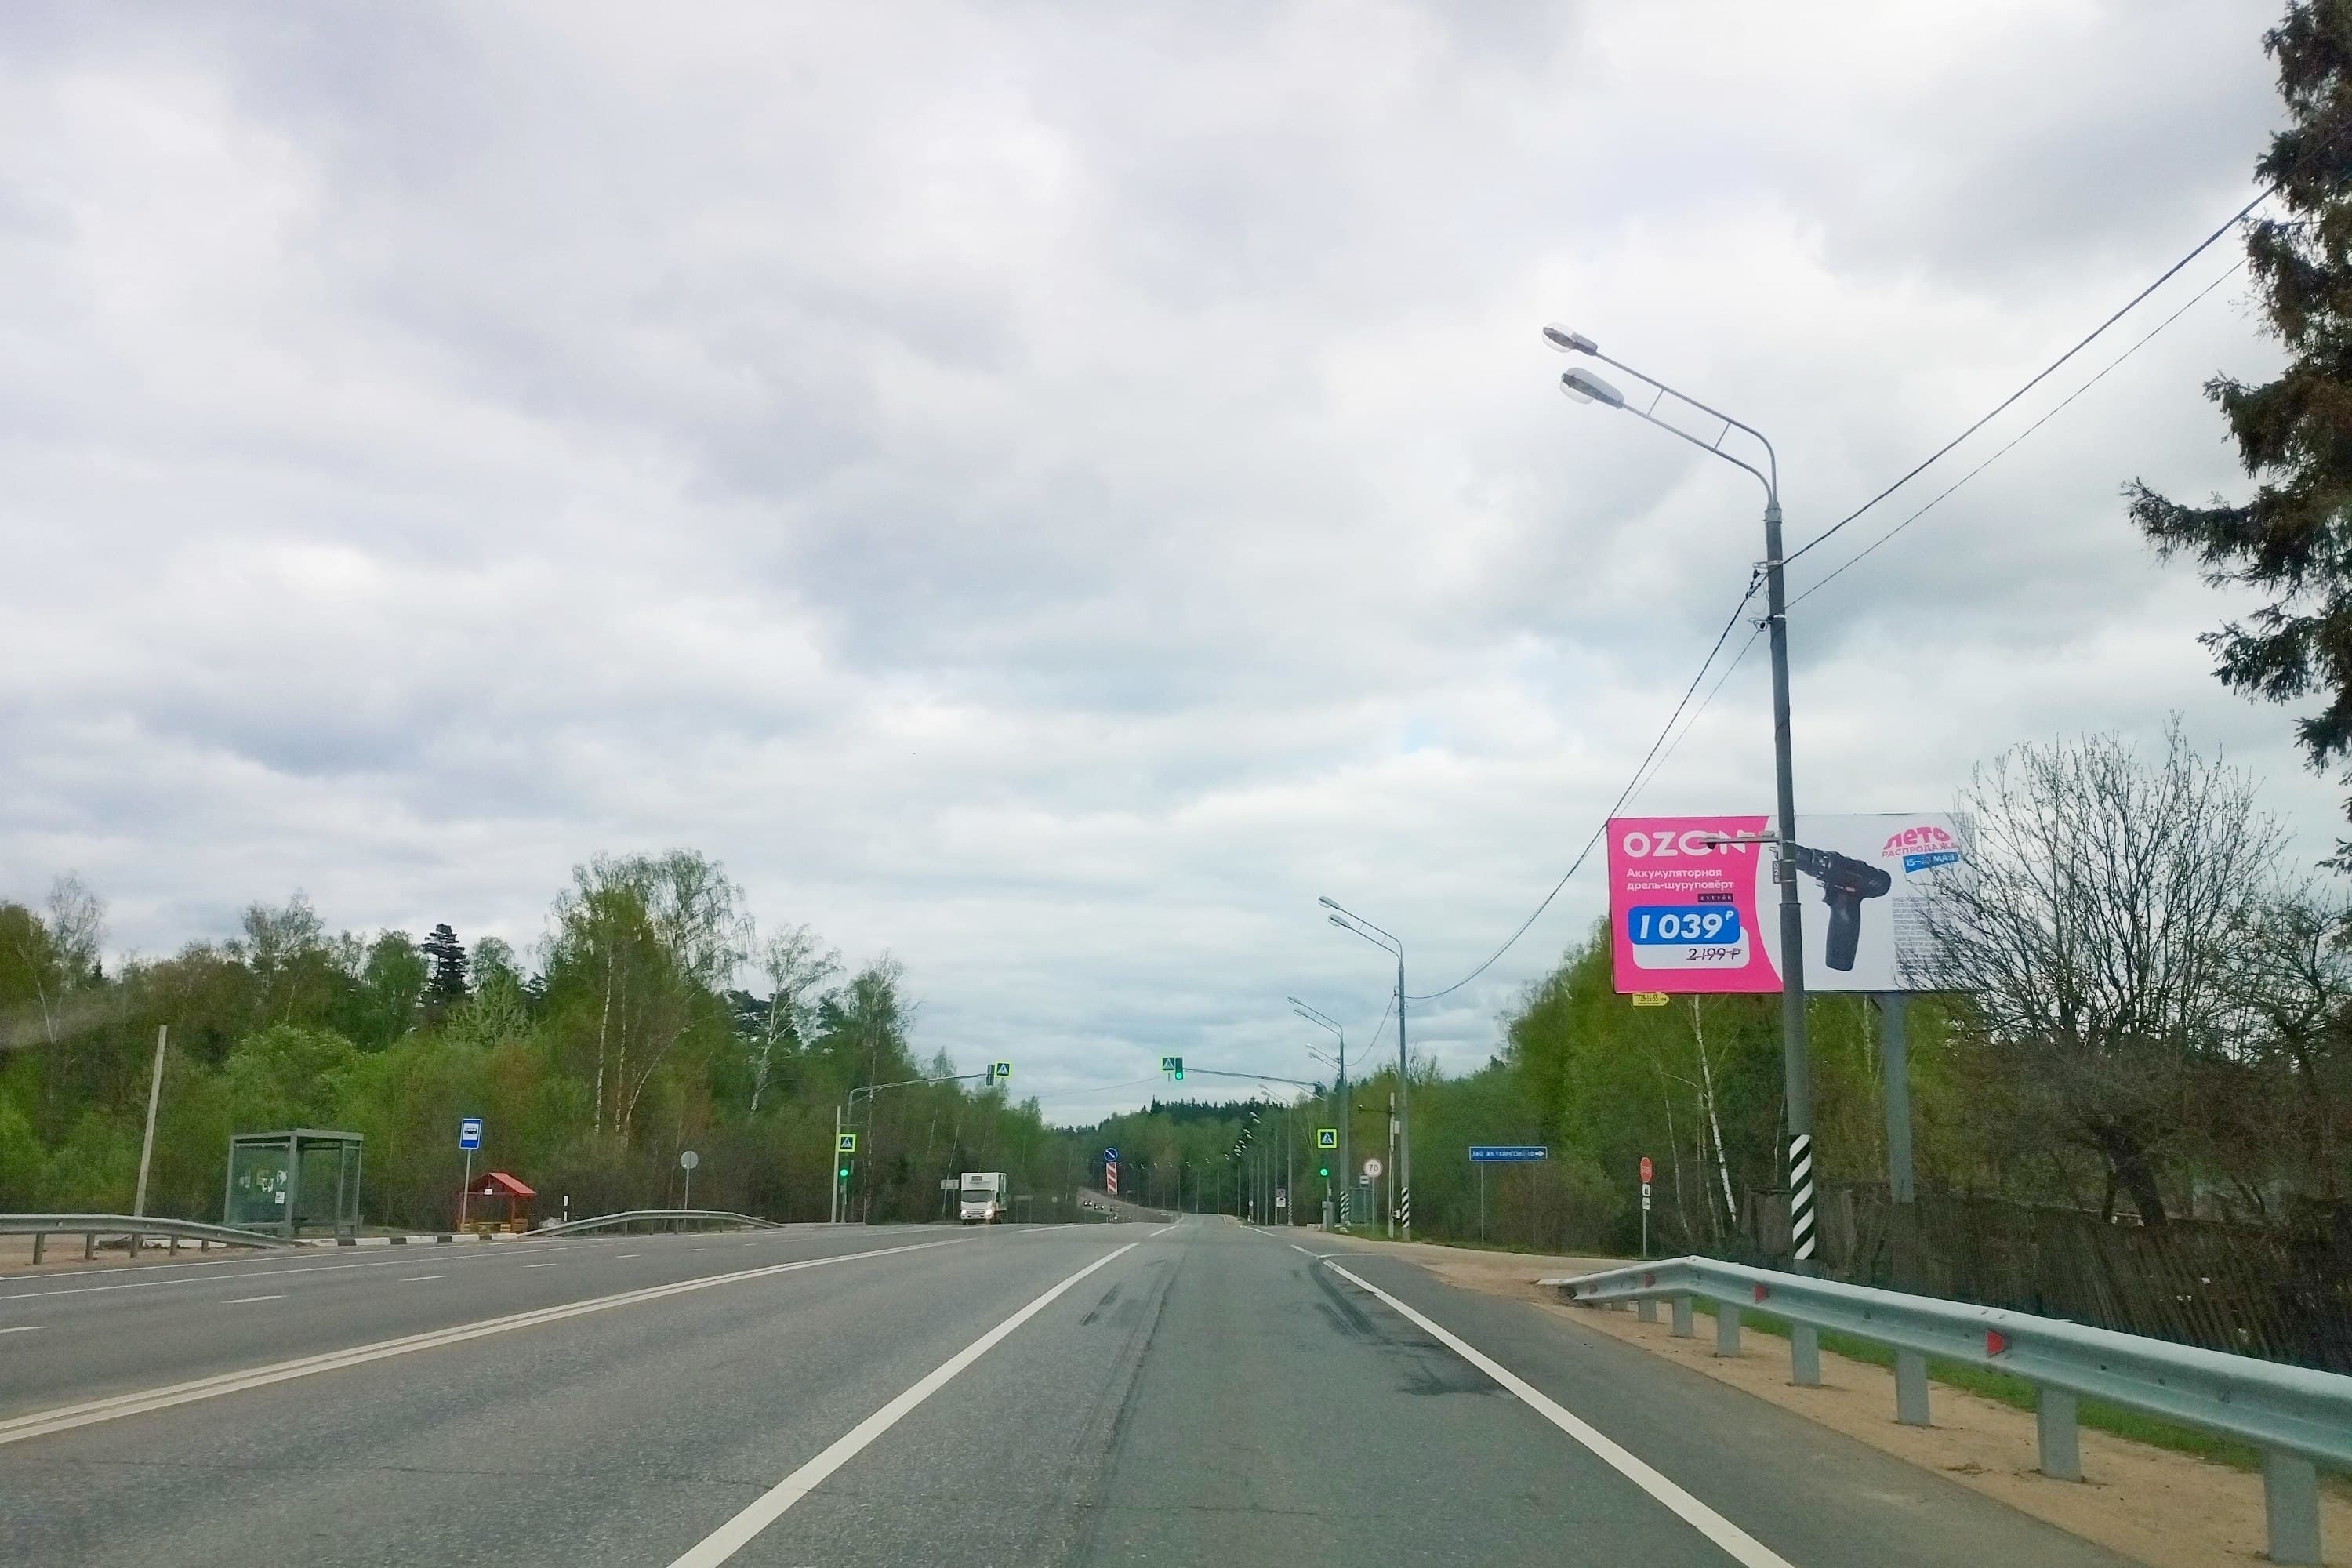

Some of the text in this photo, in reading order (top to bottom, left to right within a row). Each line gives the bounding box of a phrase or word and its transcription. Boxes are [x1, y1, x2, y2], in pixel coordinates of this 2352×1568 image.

[1623, 829, 1747, 858] OZON
[1627, 868, 1722, 879] Аккумуляторная
[1626, 880, 1734, 891] дрель-шуруповёрт
